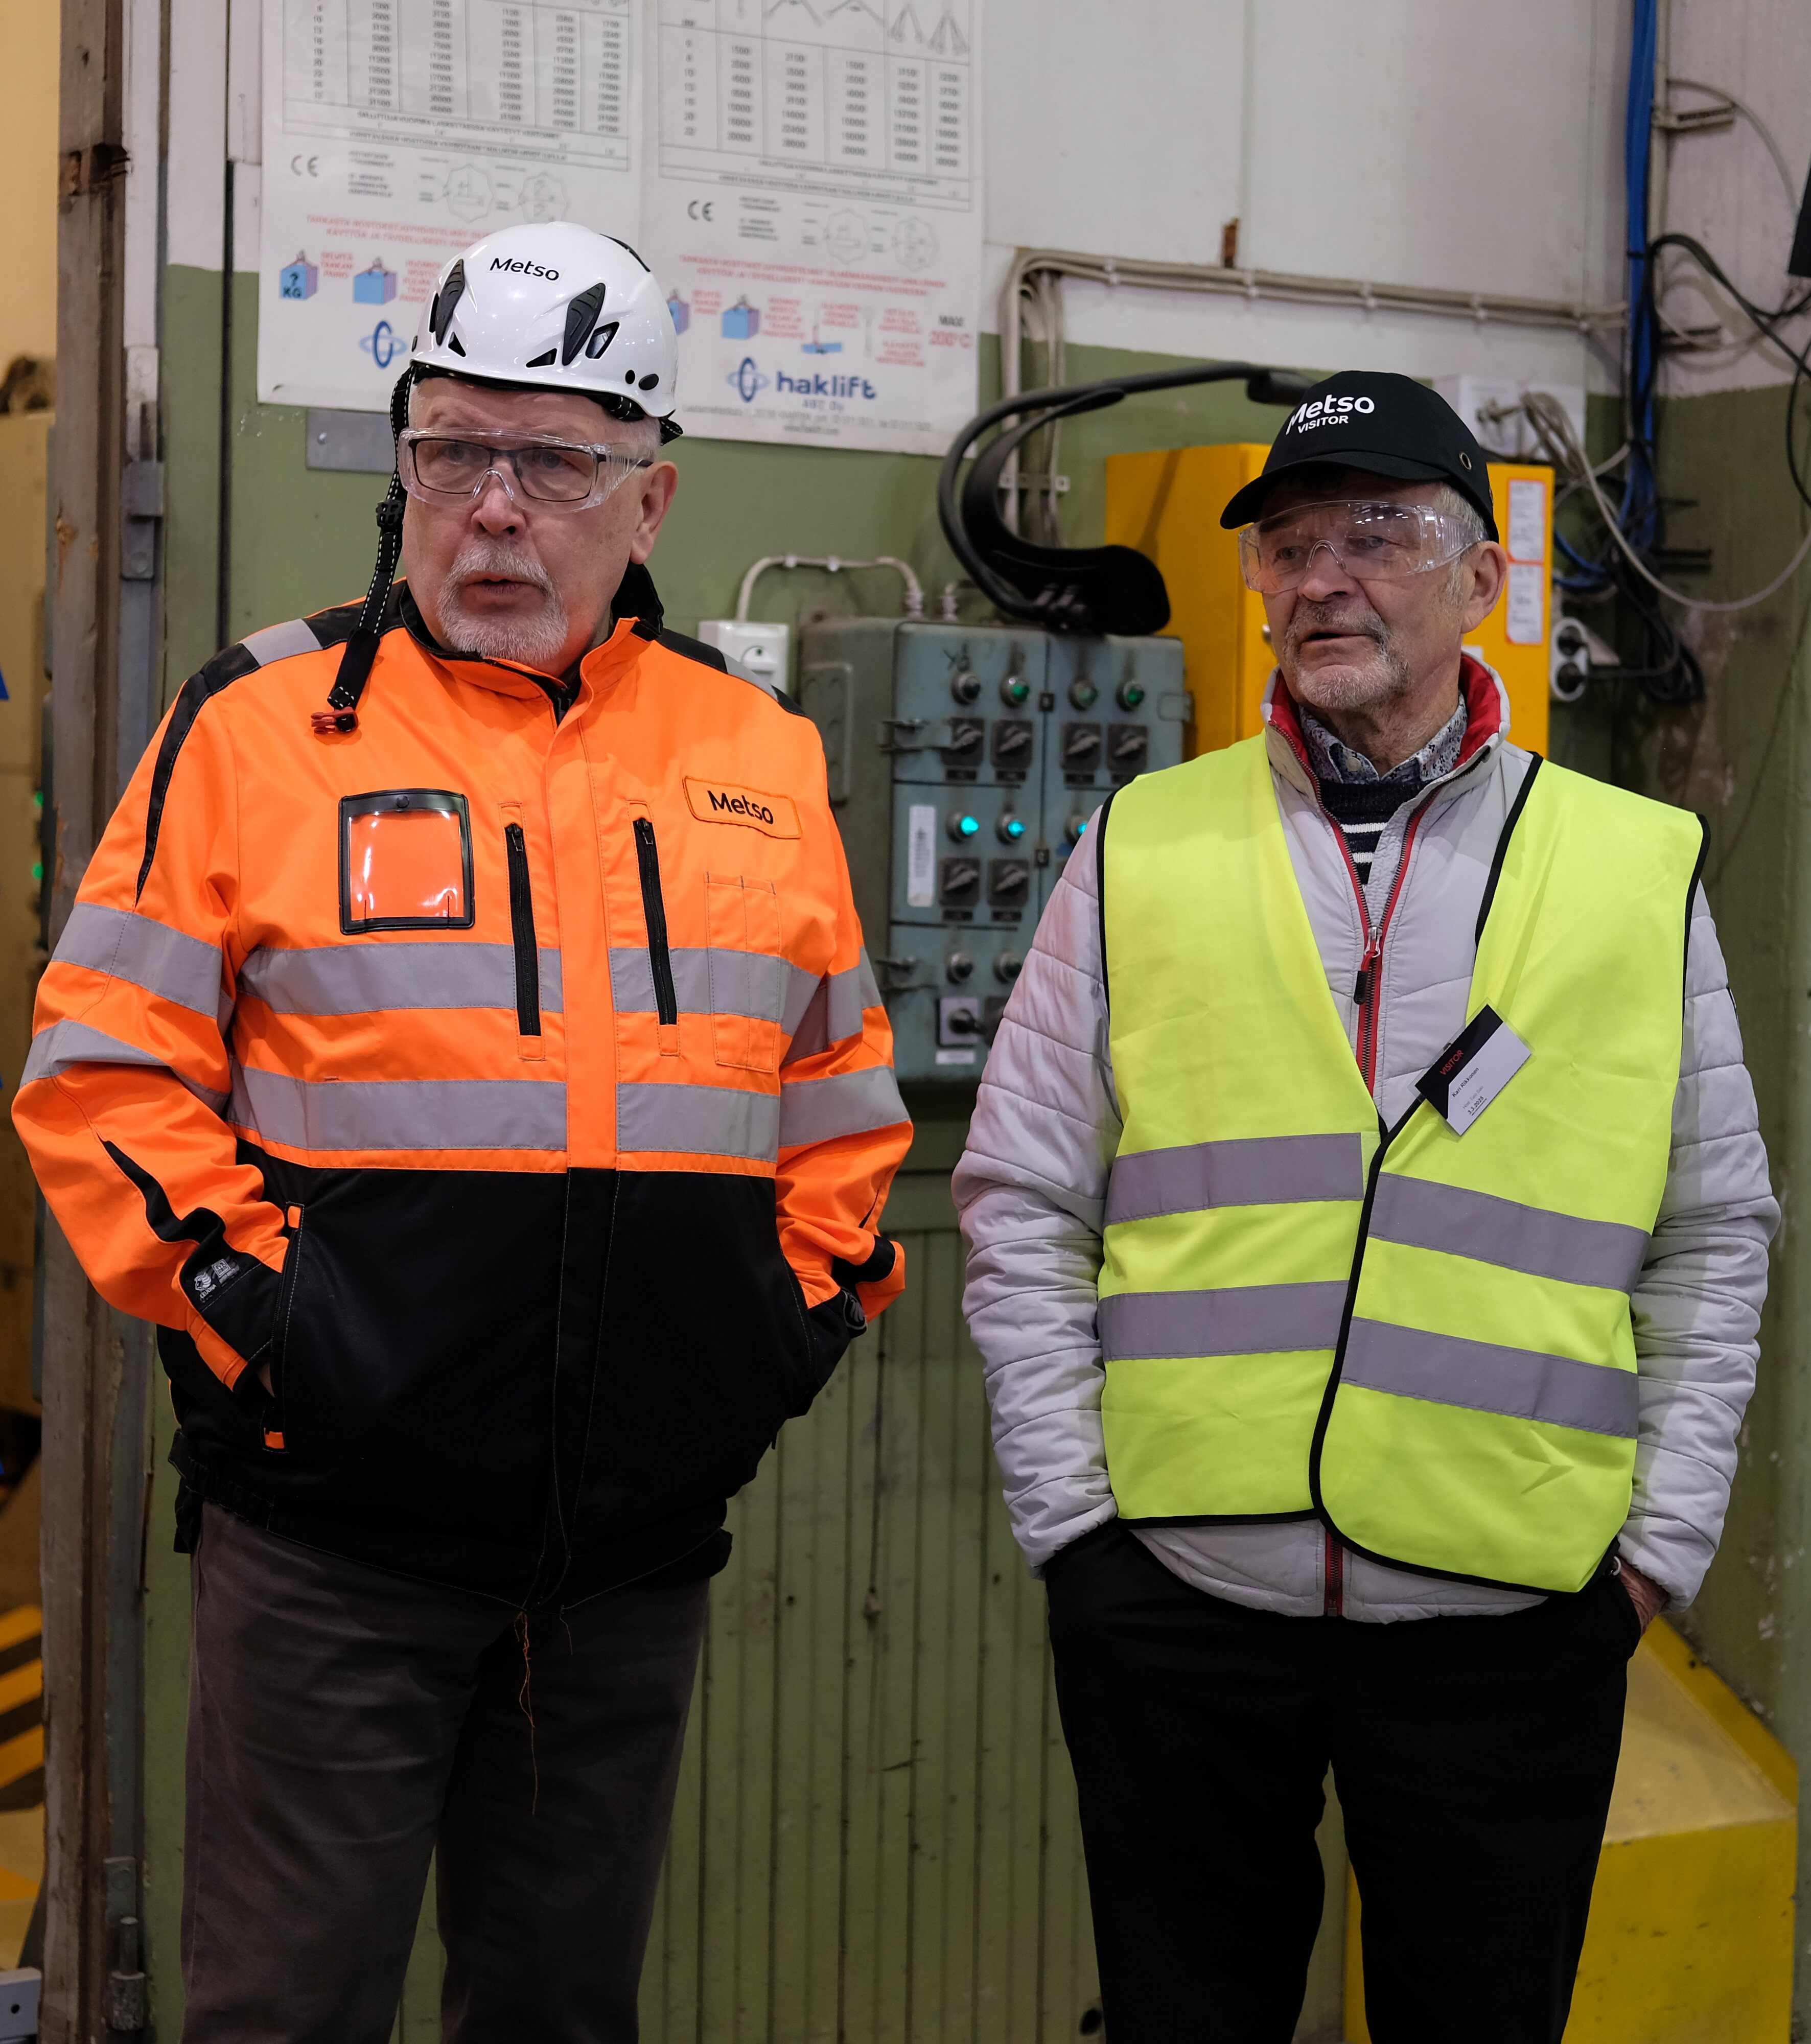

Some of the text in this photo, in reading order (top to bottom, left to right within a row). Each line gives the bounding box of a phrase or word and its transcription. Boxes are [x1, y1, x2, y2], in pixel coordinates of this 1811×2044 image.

[489, 258, 559, 281] Metso
[283, 286, 301, 298] KG
[776, 371, 877, 400] haklift
[1286, 394, 1375, 435] Metso
[1298, 415, 1349, 433] VISITOR
[707, 790, 774, 824] Metso
[1439, 1050, 1464, 1075] VISITOR
[1452, 1087, 1461, 1098] Kari
